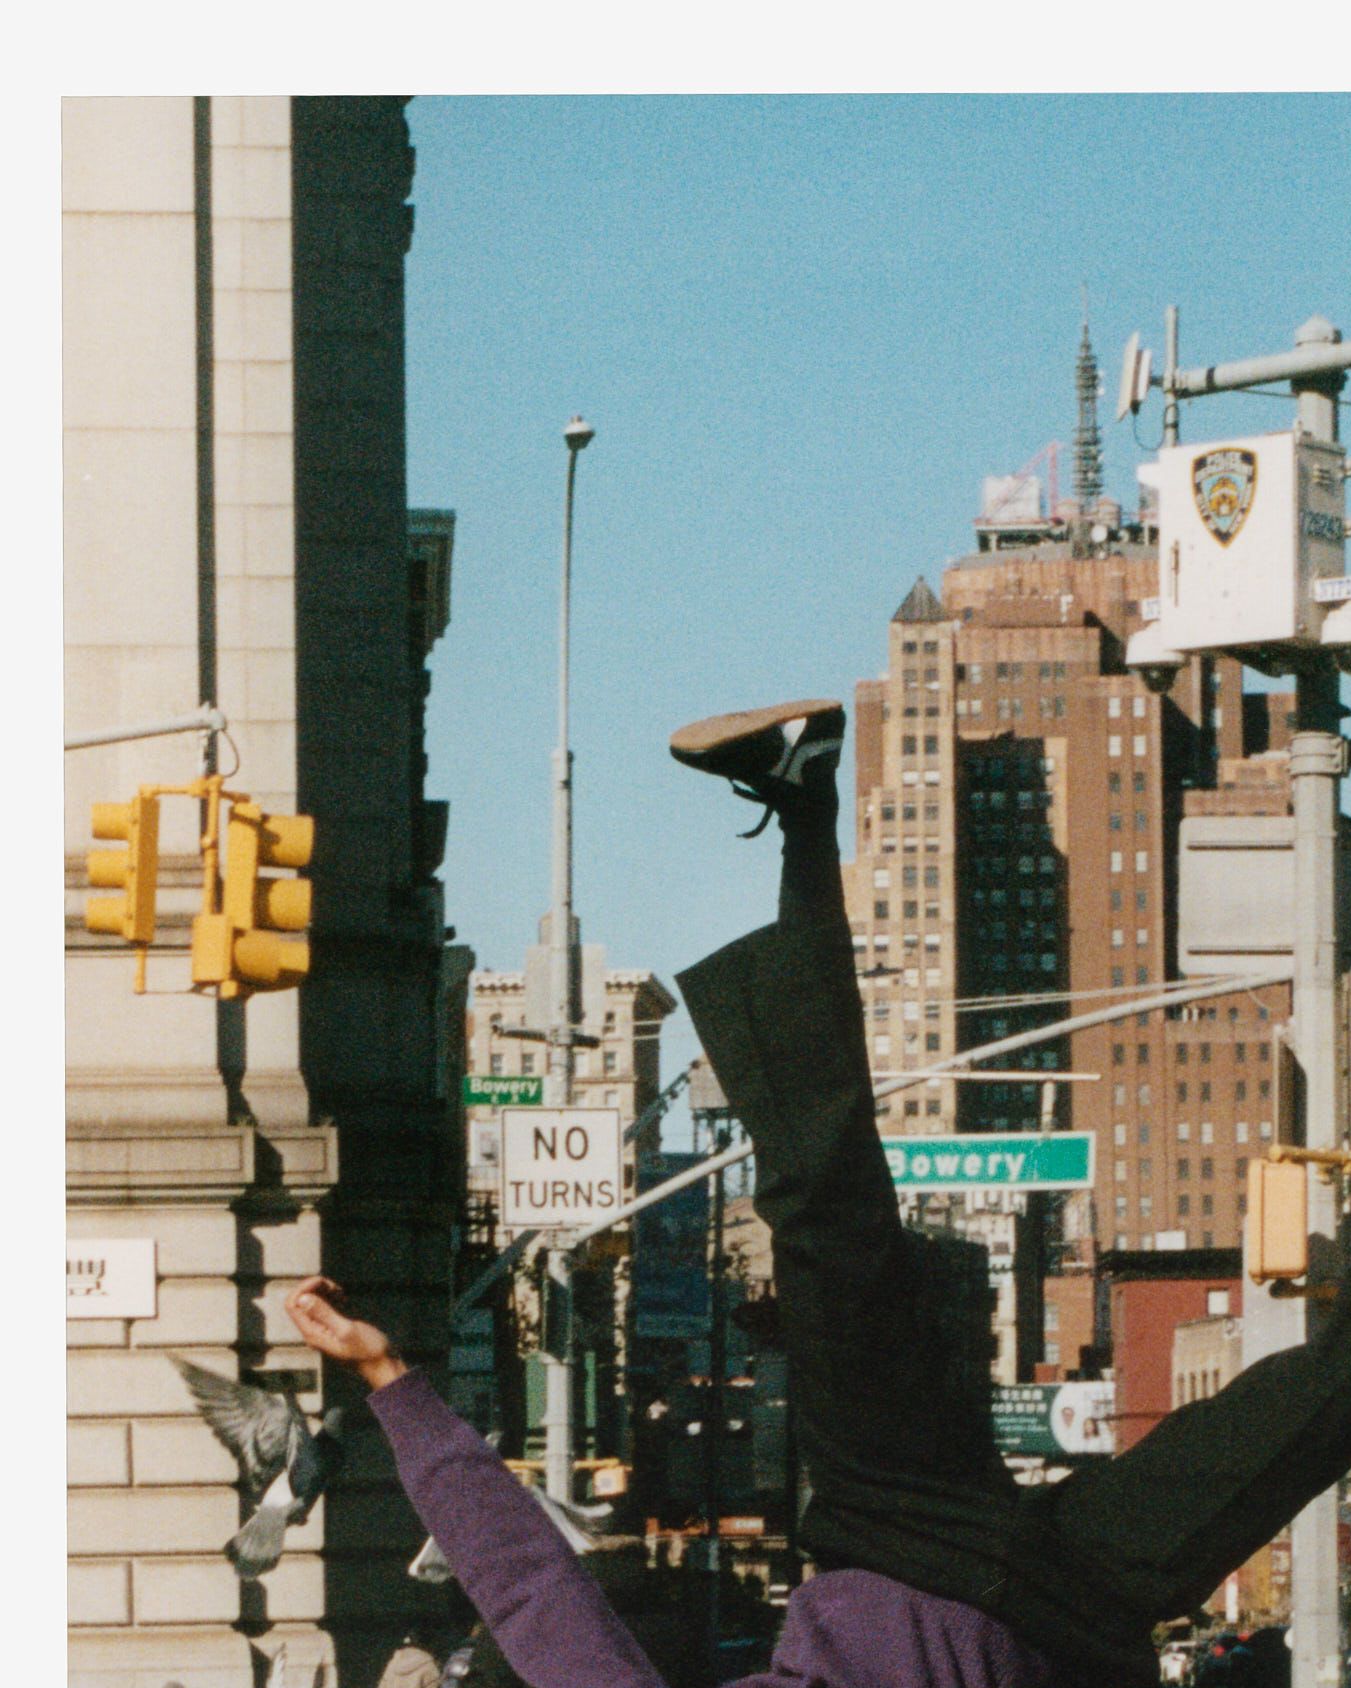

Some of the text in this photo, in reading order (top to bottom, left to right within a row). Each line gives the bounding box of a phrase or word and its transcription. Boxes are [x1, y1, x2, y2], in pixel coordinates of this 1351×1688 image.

[470, 1078, 539, 1098] Bowery
[533, 1126, 589, 1160] NO
[509, 1180, 615, 1208] TURNS
